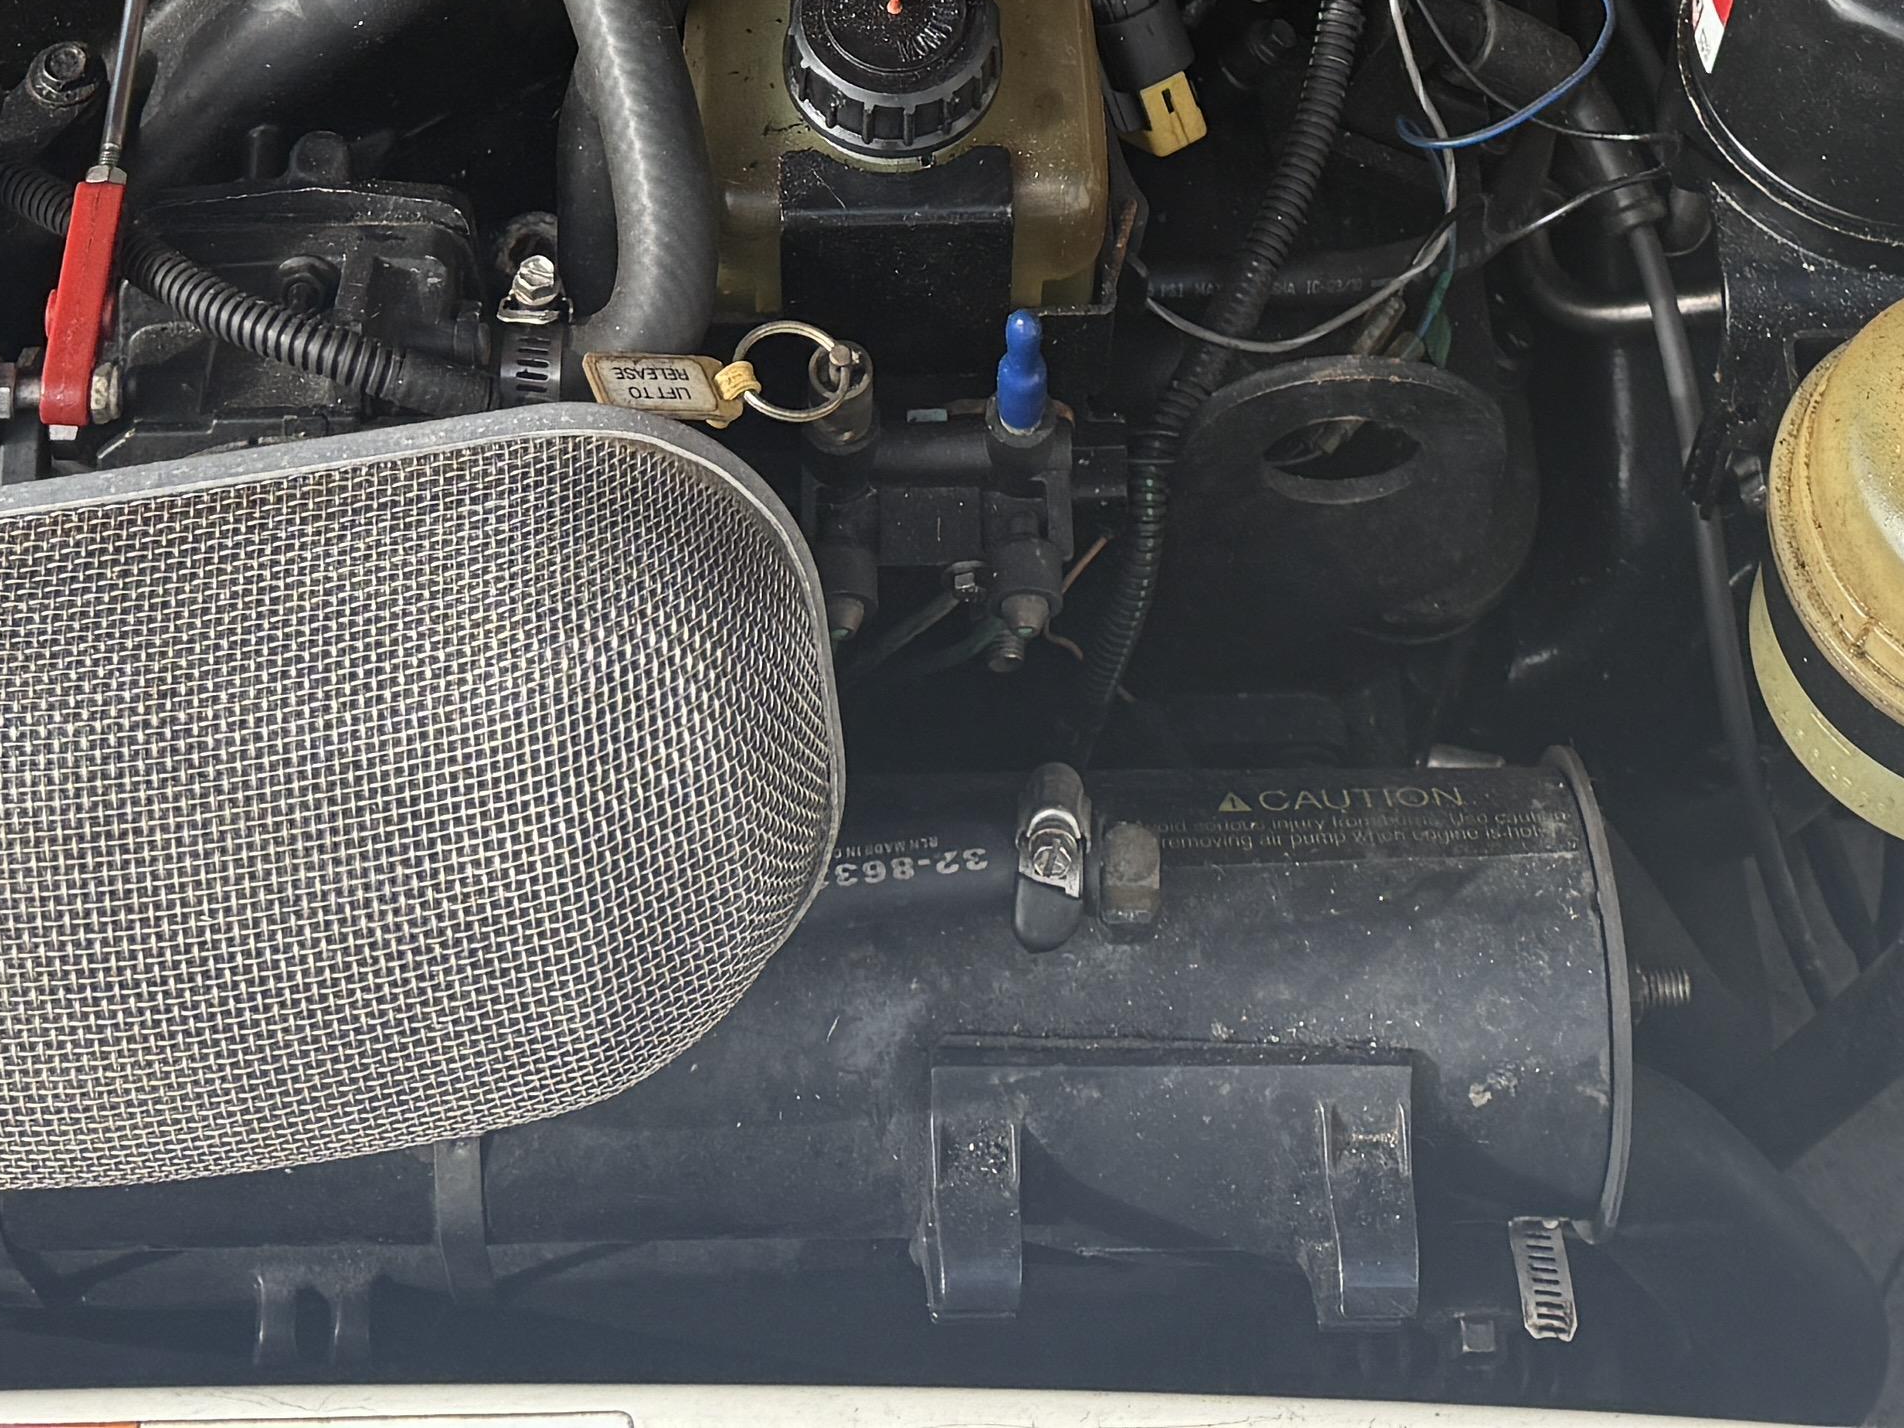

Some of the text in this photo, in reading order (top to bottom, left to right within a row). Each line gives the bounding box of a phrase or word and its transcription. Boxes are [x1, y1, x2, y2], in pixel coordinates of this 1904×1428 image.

[614, 365, 690, 382] RELEASE
[628, 385, 692, 401] LIFT TO
[1257, 787, 1464, 811] CAUTION
[1160, 834, 1253, 850] removing
[1290, 831, 1347, 848] pump
